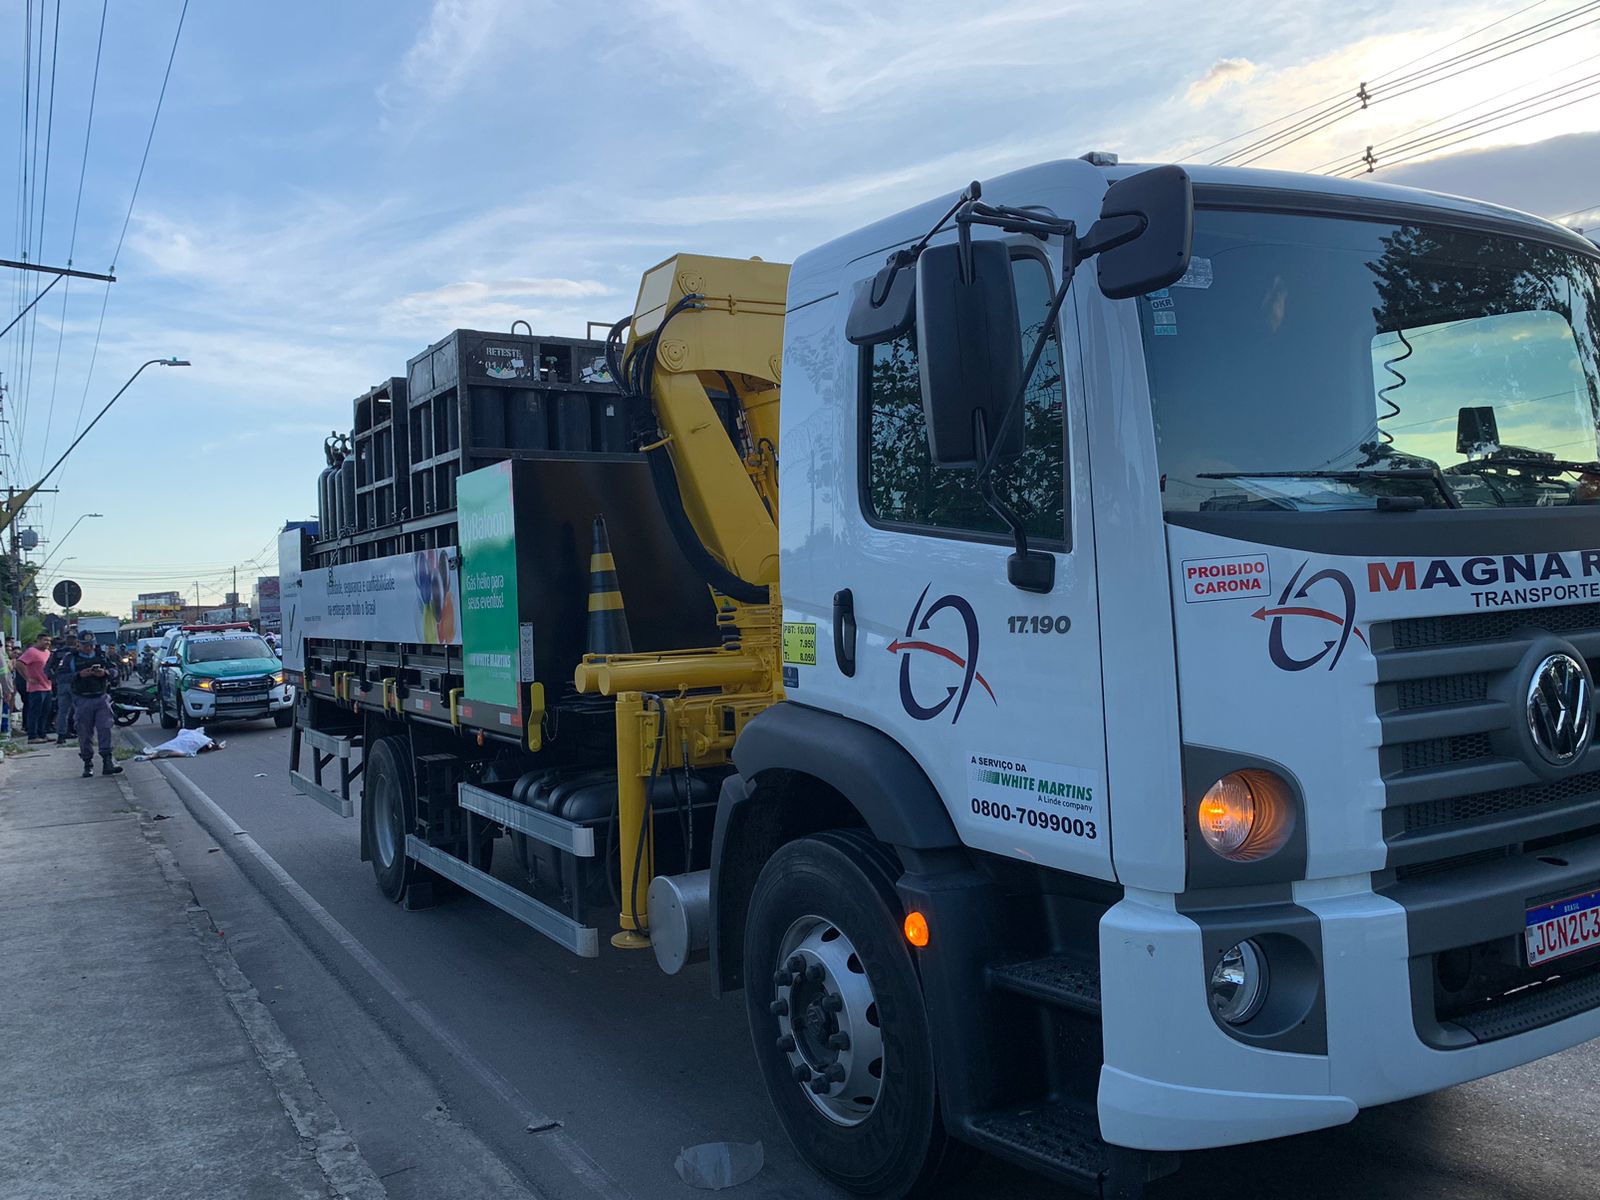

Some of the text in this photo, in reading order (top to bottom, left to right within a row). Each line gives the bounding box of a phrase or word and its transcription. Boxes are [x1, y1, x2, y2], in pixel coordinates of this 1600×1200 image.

[486, 347, 521, 358] RETESTE
[1187, 562, 1264, 579] PROIBIDO
[1367, 552, 1571, 592] MAGNA
[1194, 578, 1261, 594] CARONA
[1008, 615, 1071, 634] 17.190
[971, 756, 1027, 772] A SERVIÇO DA
[1001, 773, 1092, 801] WHITE MARTINS
[1044, 796, 1061, 806] Linde
[1063, 801, 1092, 813] company
[971, 798, 1097, 839] 0800-7099003
[1536, 908, 1600, 956] JCN2C3
